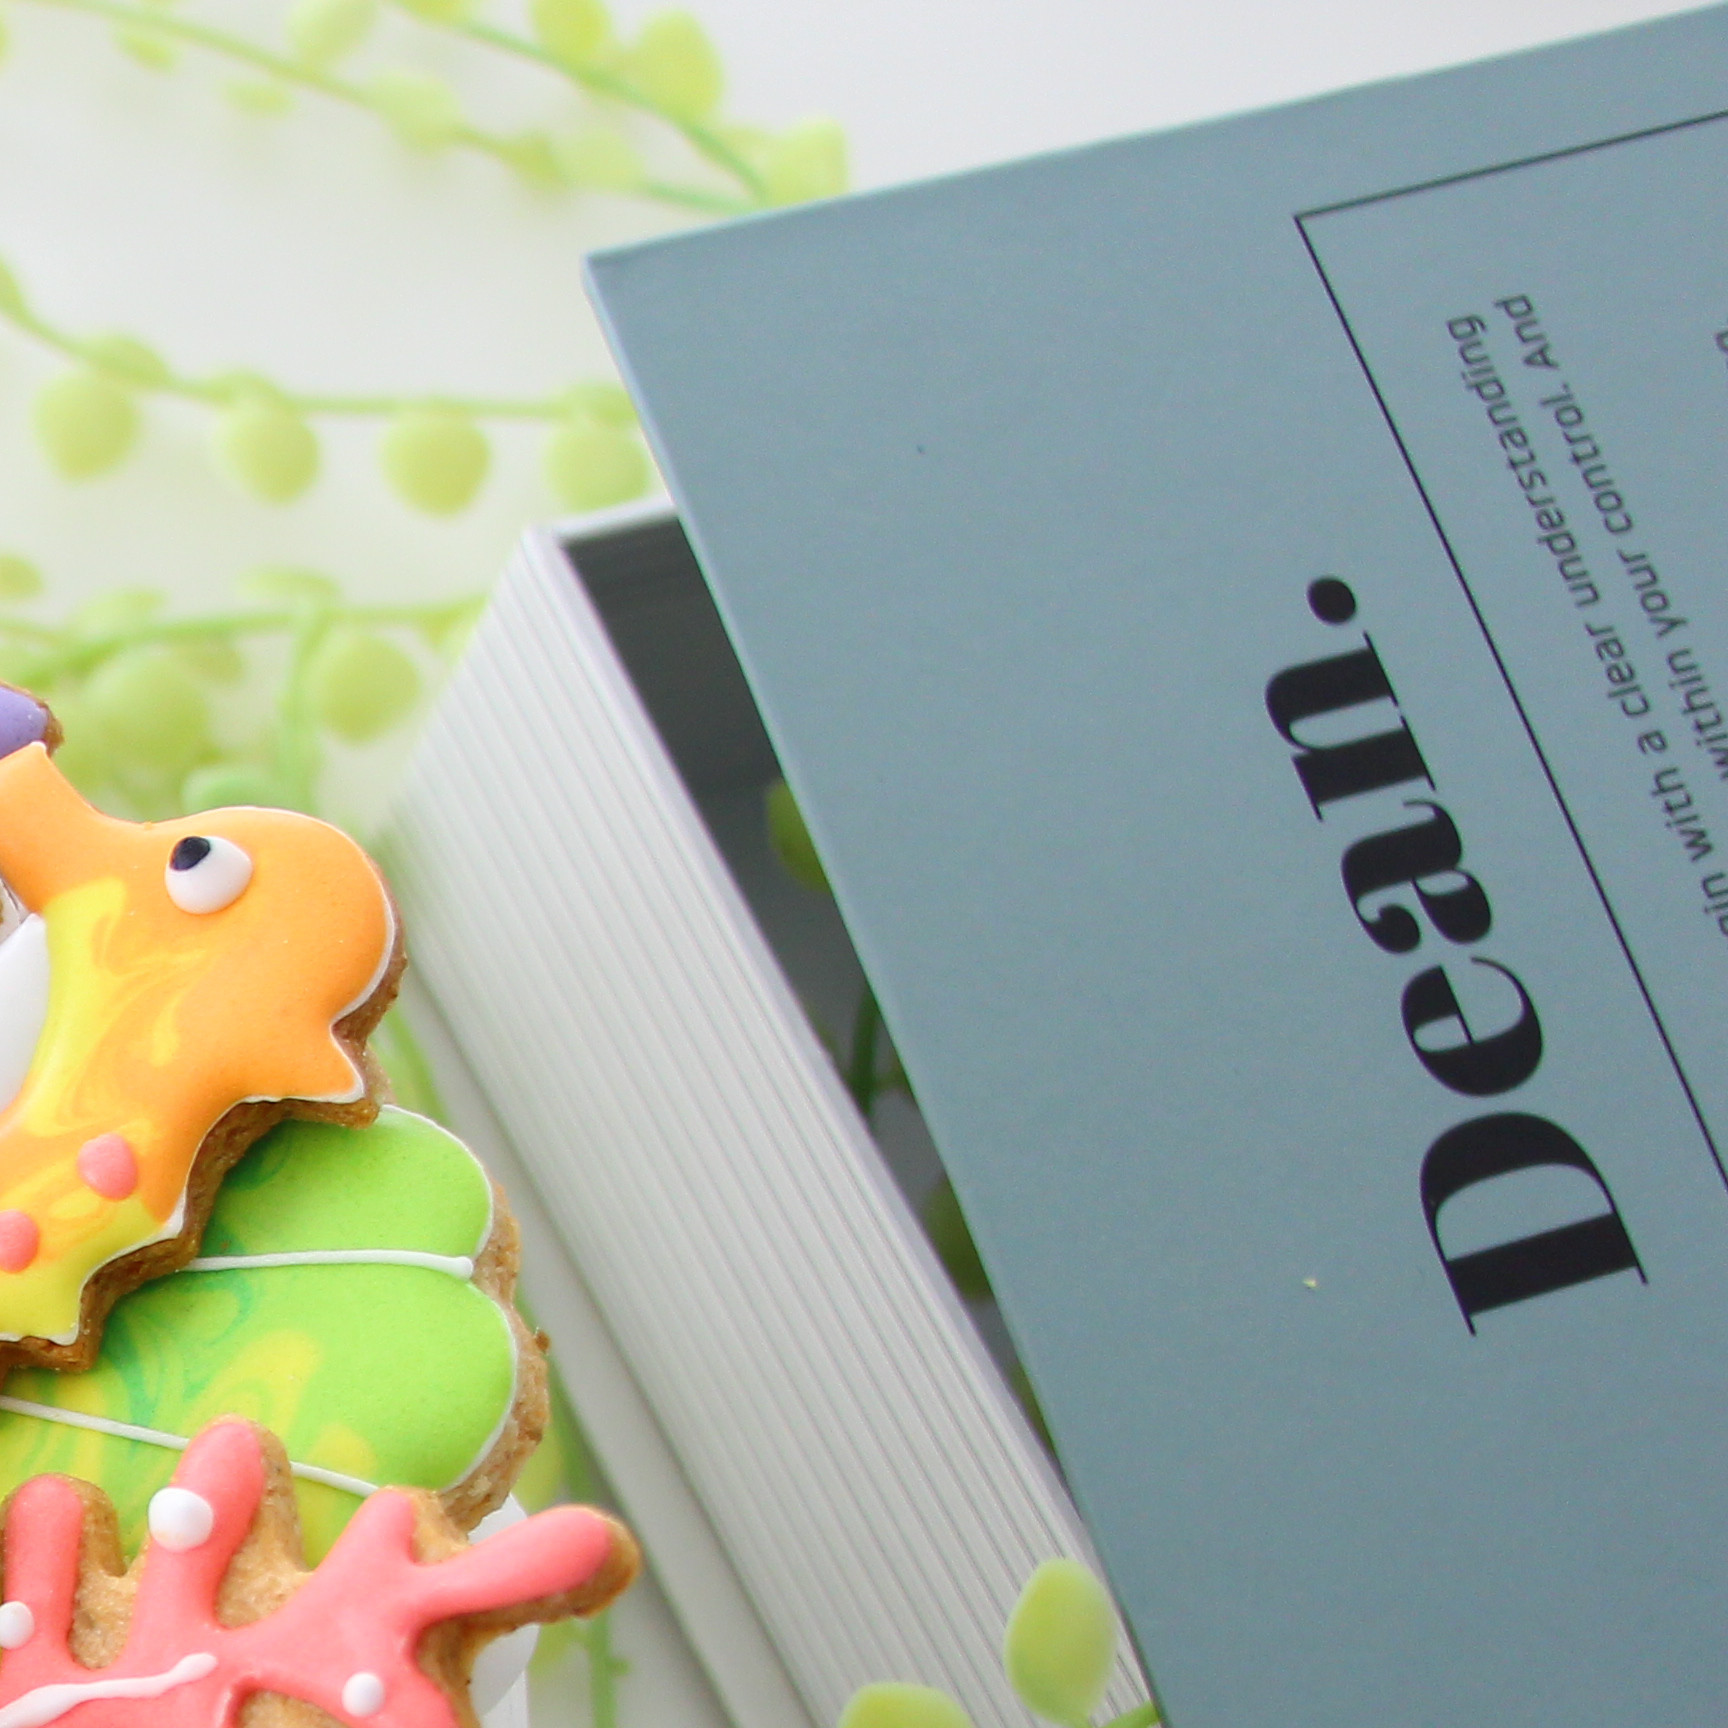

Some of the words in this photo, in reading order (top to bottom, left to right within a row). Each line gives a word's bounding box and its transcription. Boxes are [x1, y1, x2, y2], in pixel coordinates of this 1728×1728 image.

[1494, 294, 1561, 370] And
[1446, 314, 1601, 607] understanding
[1539, 382, 1634, 535] control.
[1617, 548, 1688, 639] your
[1585, 621, 1651, 718] clear
[1666, 648, 1728, 782] within
[1637, 729, 1668, 754] a
[1651, 767, 1713, 862] with
[1264, 576, 1647, 1336] Dean.
